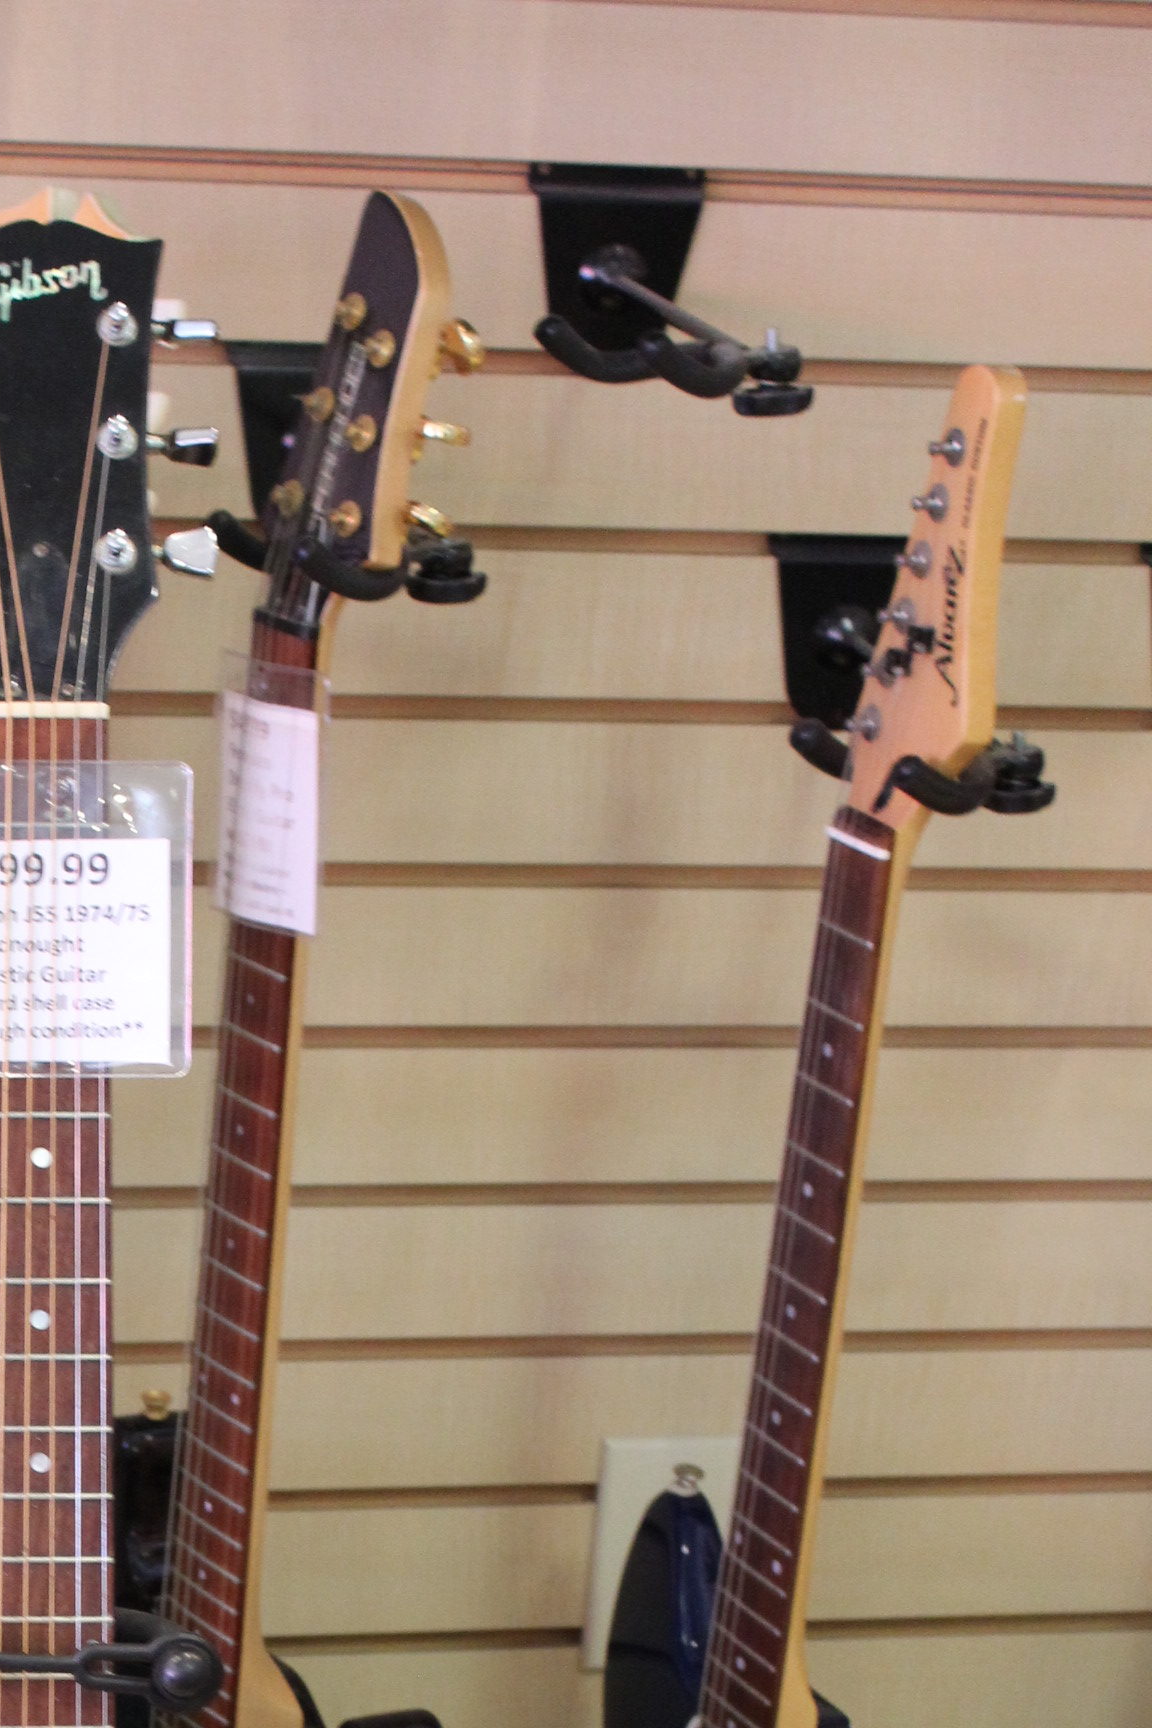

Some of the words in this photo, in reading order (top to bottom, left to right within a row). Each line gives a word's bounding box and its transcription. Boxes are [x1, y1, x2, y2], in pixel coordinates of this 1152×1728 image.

[40, 965, 108, 984] Guitar
[24, 994, 69, 1012] shell
[73, 998, 116, 1012] case
